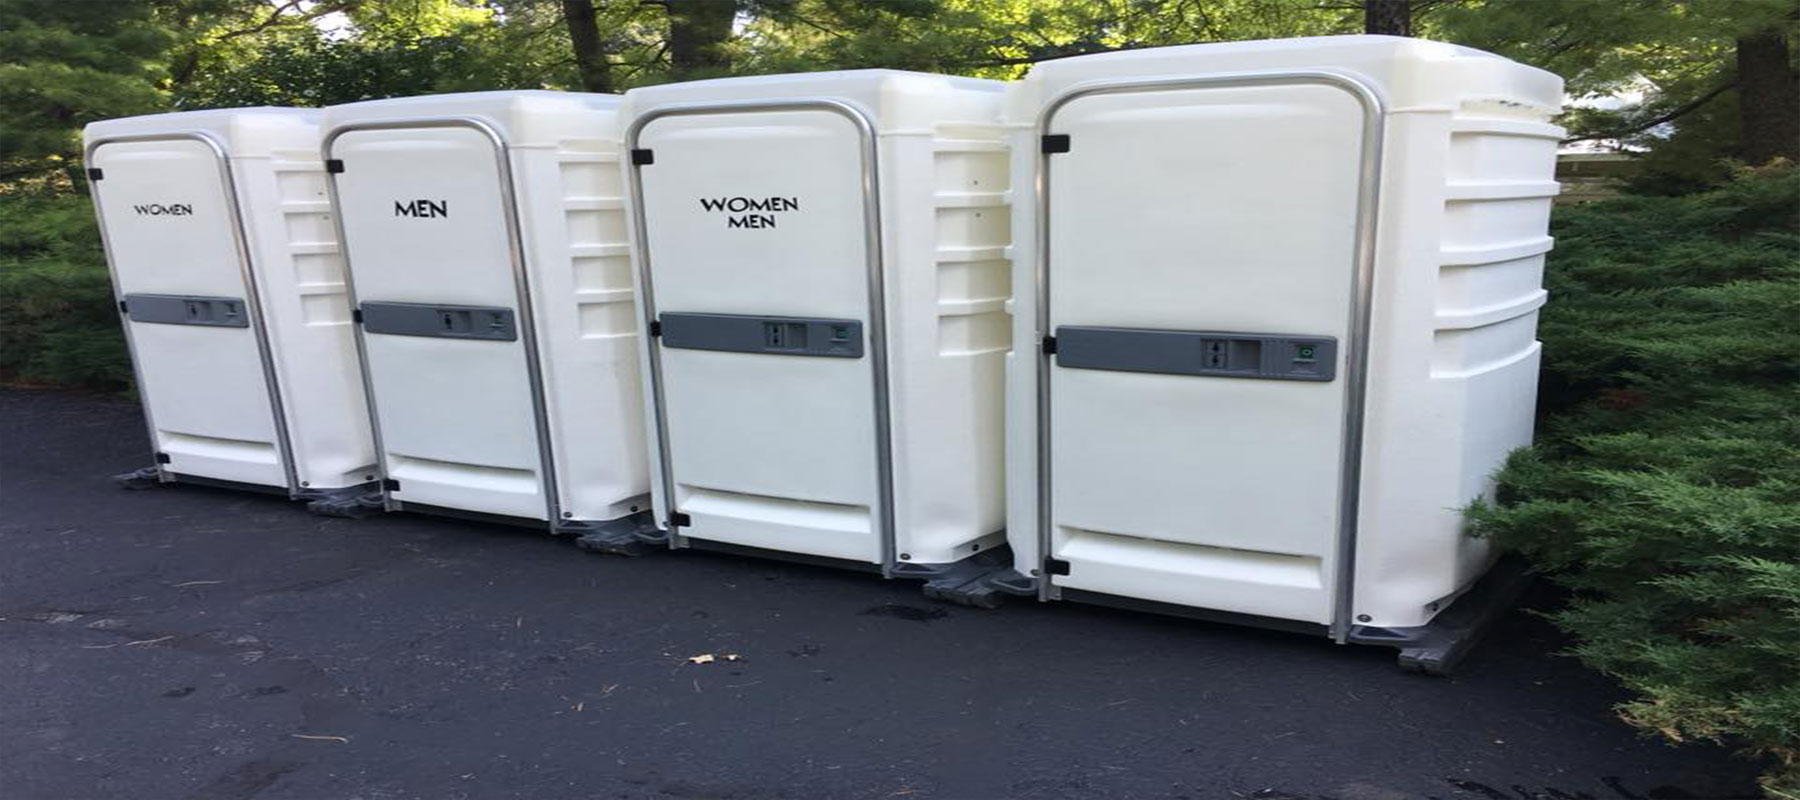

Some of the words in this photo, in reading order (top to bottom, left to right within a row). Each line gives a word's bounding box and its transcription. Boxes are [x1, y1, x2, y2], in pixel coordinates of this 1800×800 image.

[133, 203, 193, 216] WOMEN
[395, 200, 448, 218] MEN
[700, 197, 799, 212] WOMEN
[728, 214, 776, 229] MEN
